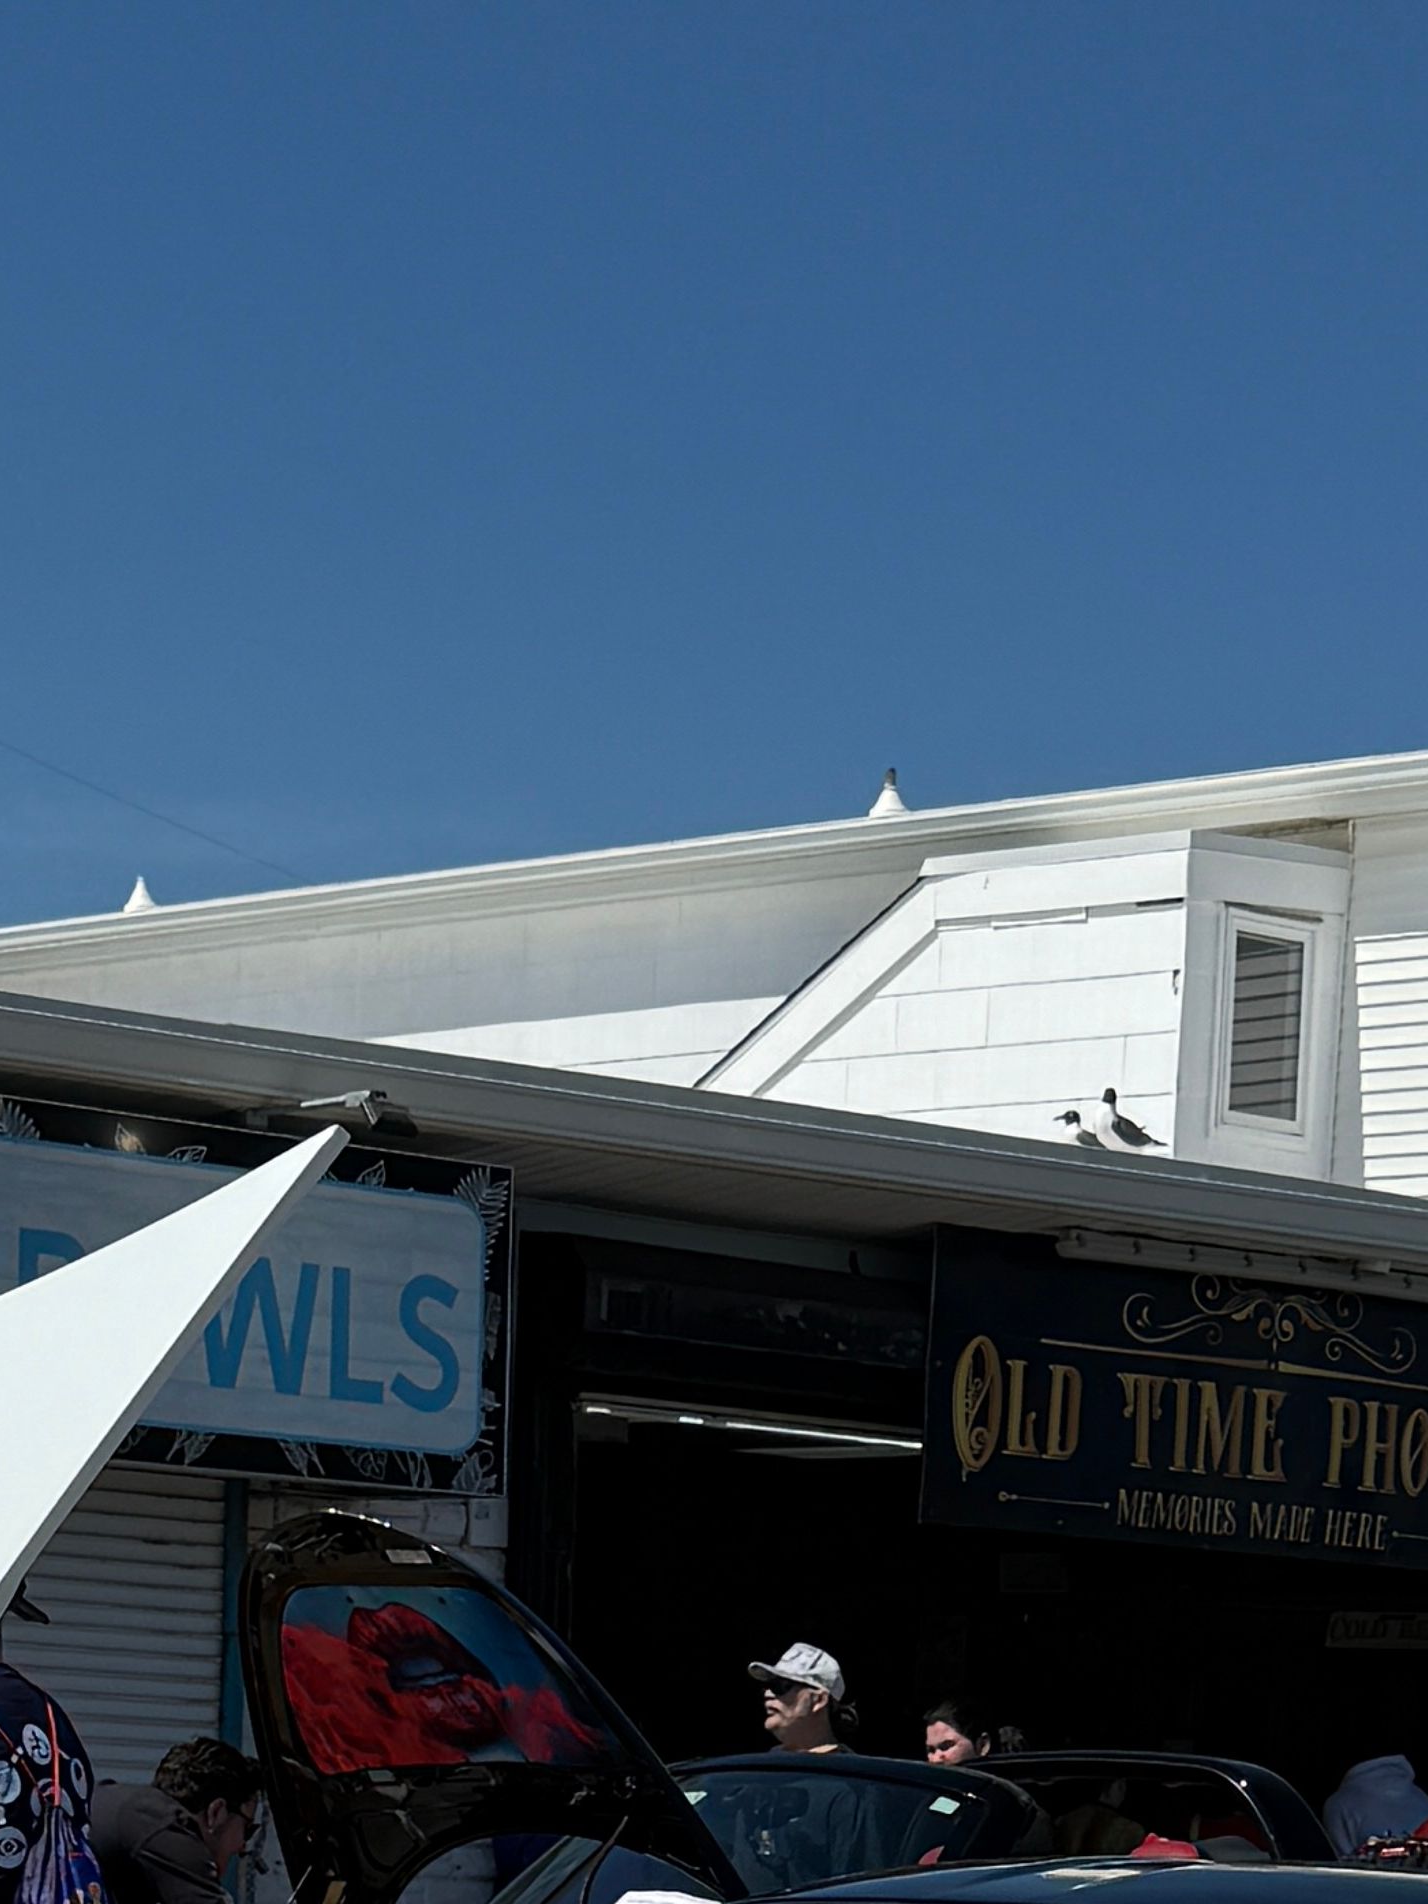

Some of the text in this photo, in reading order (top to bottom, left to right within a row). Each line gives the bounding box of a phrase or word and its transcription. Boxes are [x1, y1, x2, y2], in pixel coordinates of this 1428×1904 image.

[953, 1335, 1084, 1481] OLD
[1116, 1372, 1288, 1483] TIME
[1116, 1488, 1389, 1552] MEMORIES MADE HERE
